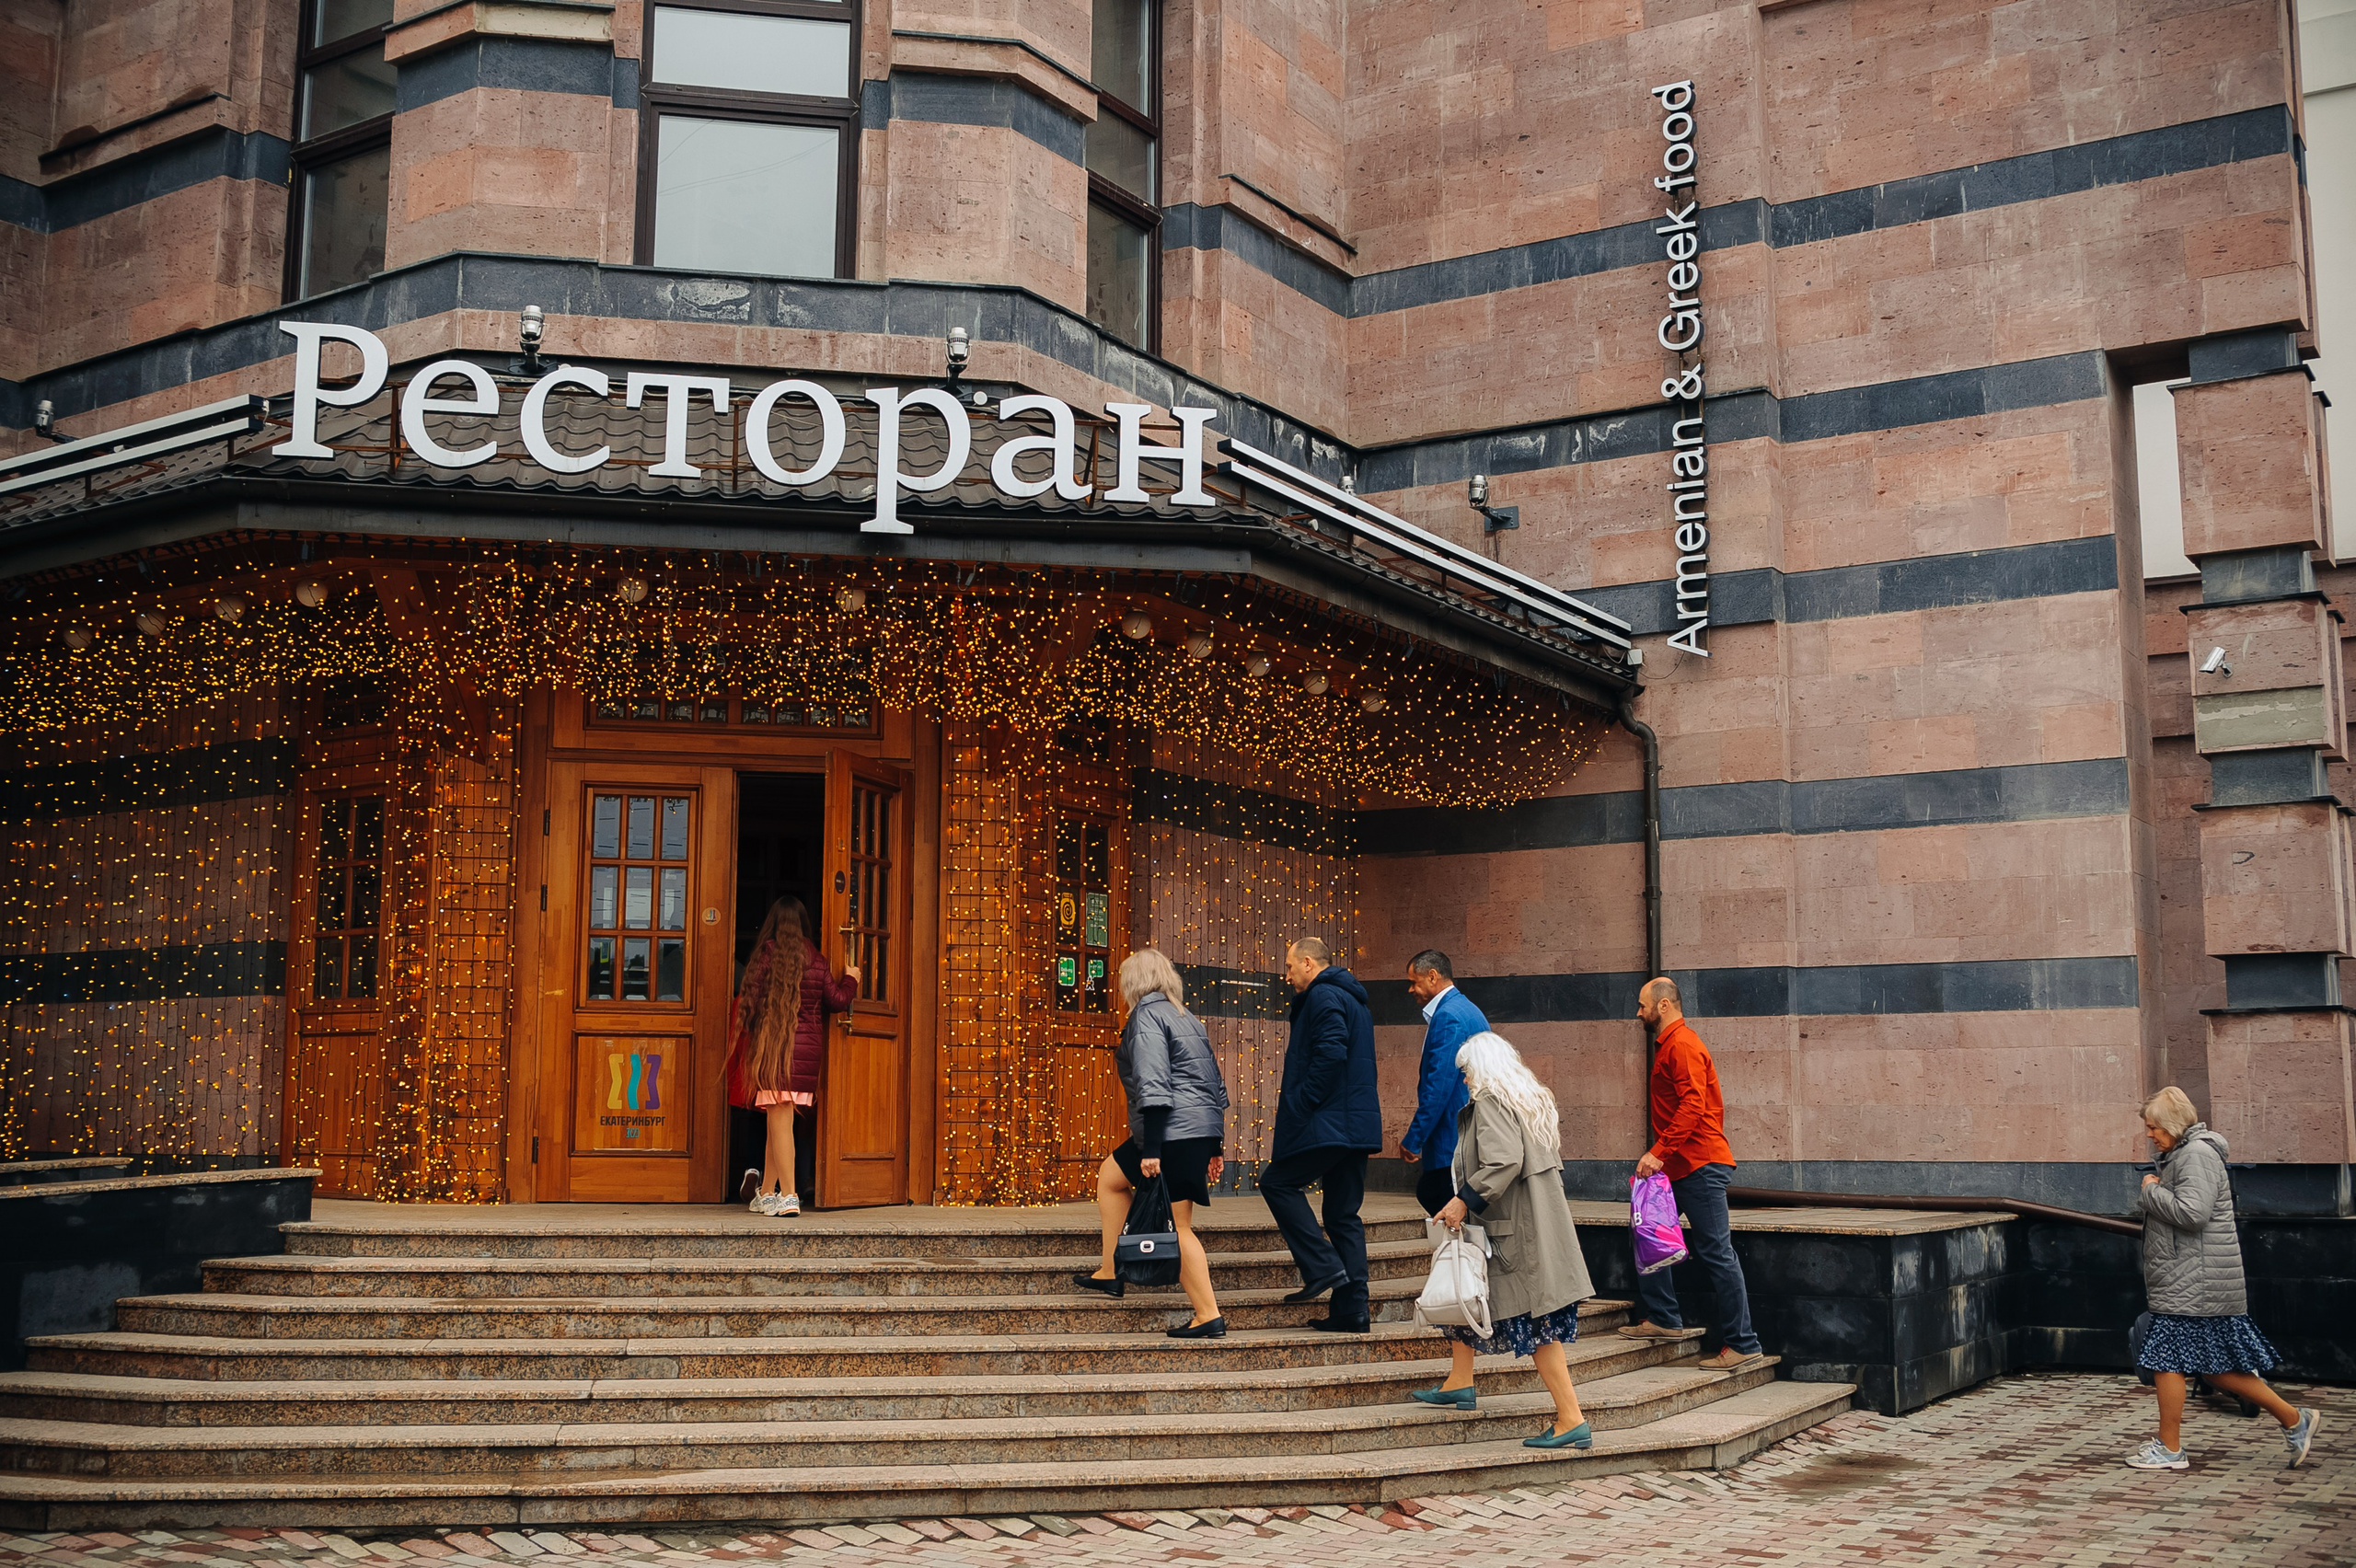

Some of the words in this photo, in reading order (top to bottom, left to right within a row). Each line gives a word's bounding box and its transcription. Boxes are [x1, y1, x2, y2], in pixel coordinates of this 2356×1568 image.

[1651, 79, 1696, 191] food
[1656, 201, 1701, 352] Greek
[271, 320, 1218, 535] Ресторан
[1660, 363, 1703, 400] &
[1666, 417, 1709, 658] Armenian
[600, 1115, 665, 1126] ЕКАТЕРИНБУРГ
